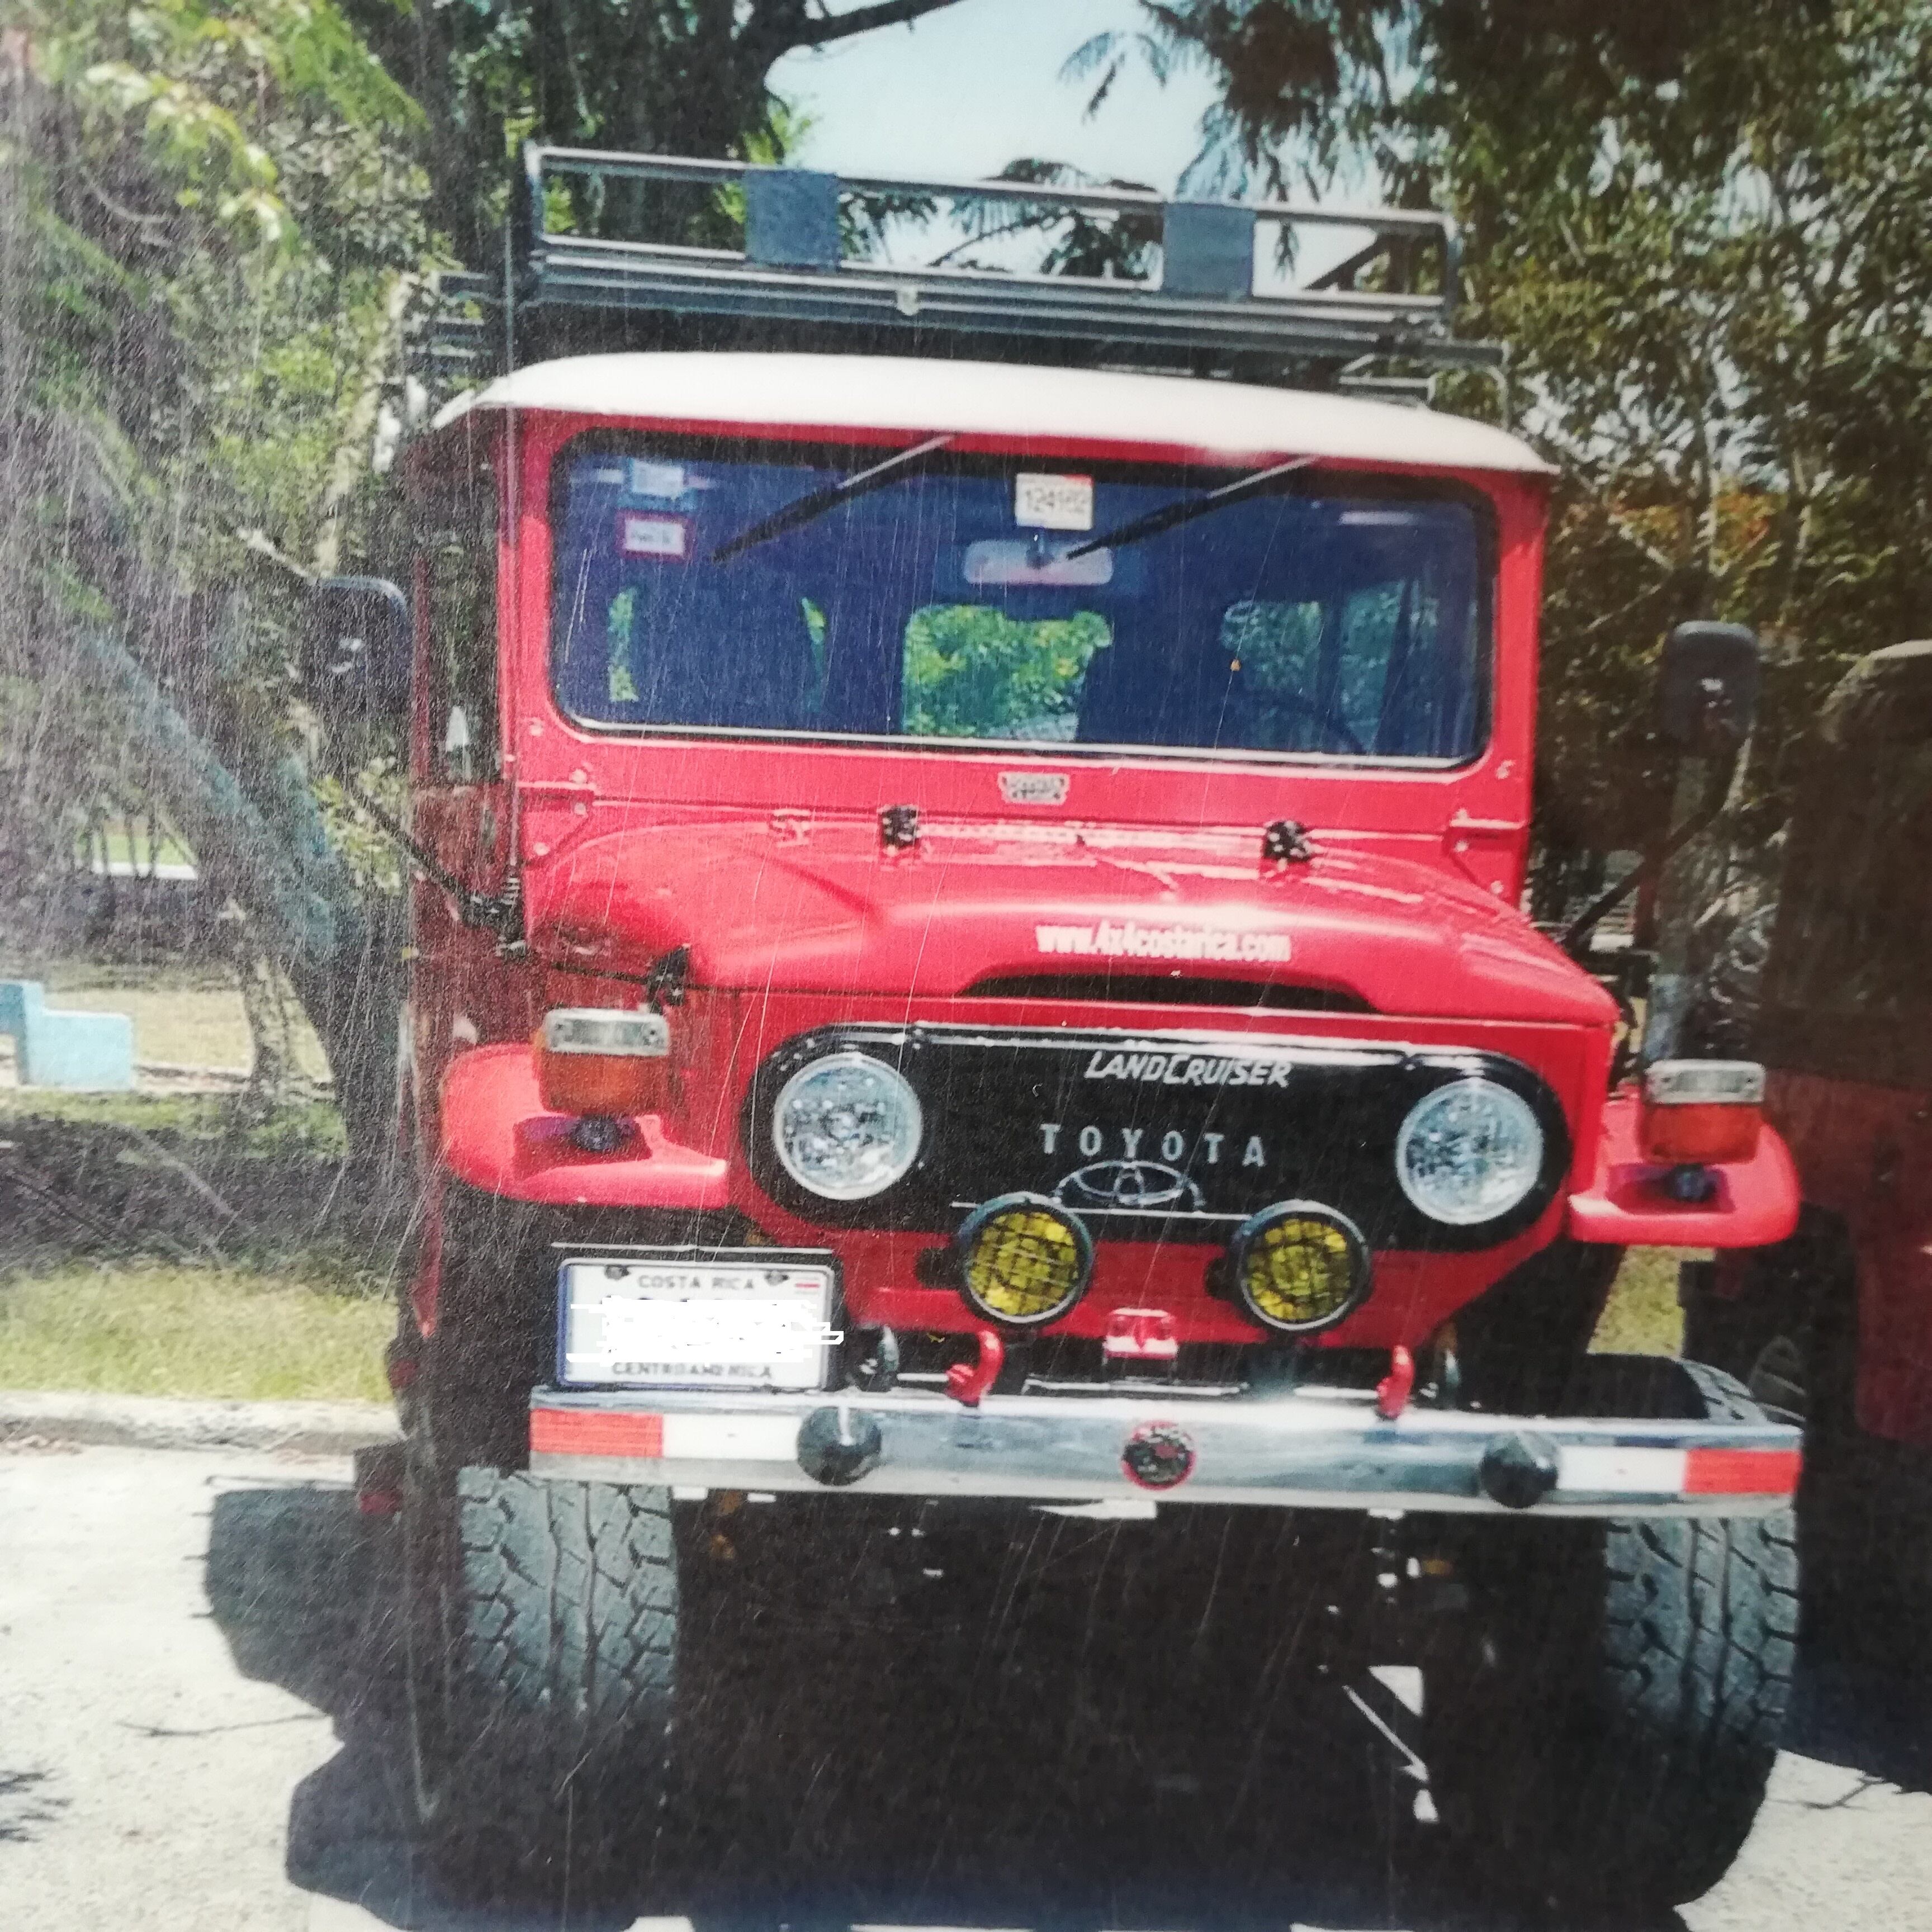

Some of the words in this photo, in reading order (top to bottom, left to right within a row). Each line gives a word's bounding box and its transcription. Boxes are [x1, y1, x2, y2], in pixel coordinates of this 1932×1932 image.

[1040, 1123, 1267, 1167] TOYOTA
[638, 1275, 699, 1289] COSTA
[712, 1277, 755, 1290] RICA
